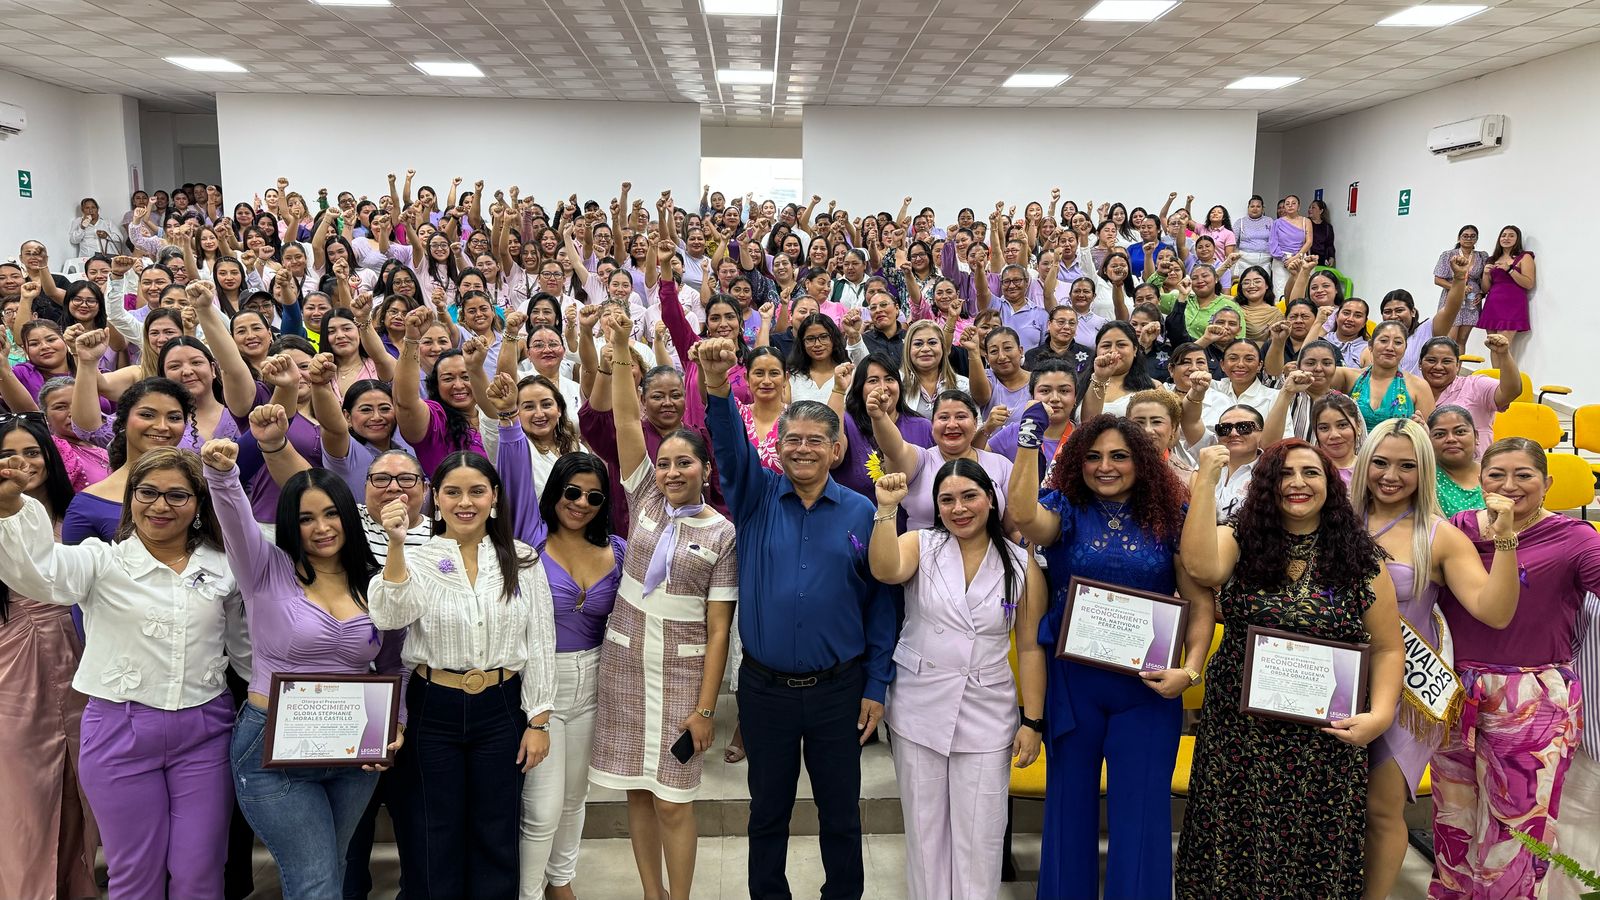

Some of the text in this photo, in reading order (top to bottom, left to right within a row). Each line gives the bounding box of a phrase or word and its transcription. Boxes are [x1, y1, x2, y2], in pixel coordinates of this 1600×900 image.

[1081, 606, 1148, 625] RECONOCIMIENTO
[1109, 618, 1140, 629] NATIVIDAD
[1261, 657, 1329, 673] RECONOCIMIENTO
[1421, 668, 1452, 706] 2025
